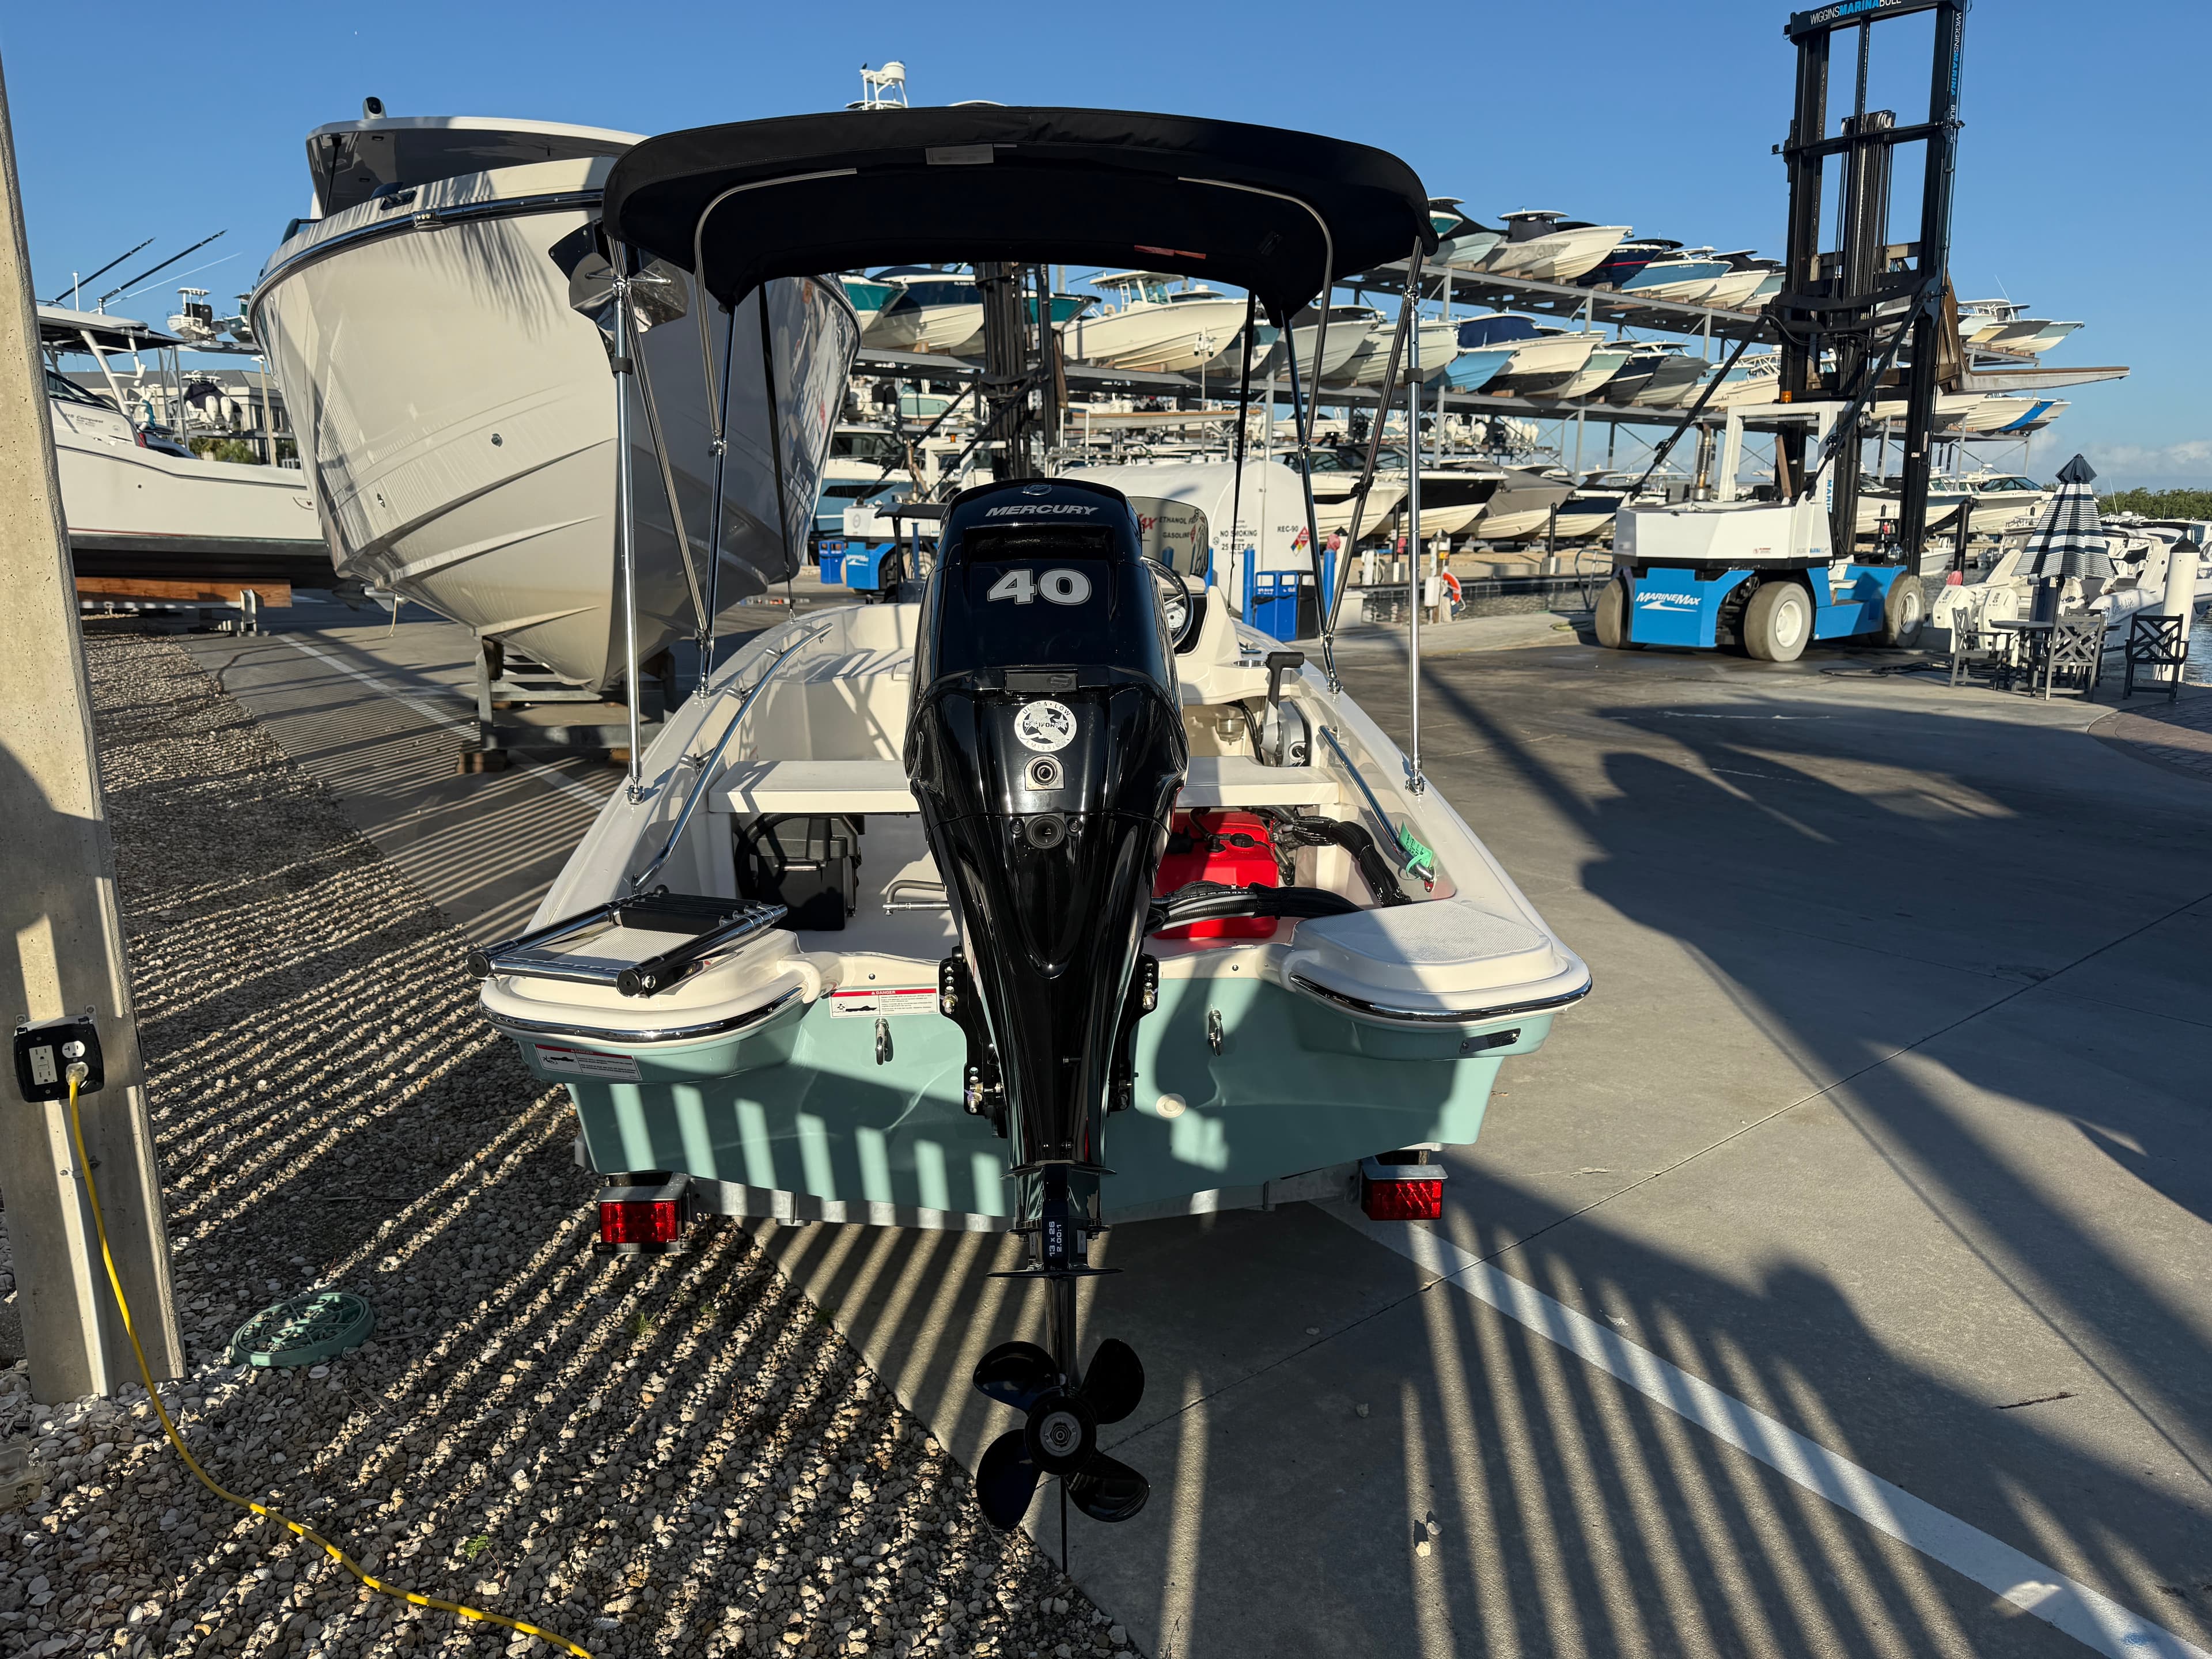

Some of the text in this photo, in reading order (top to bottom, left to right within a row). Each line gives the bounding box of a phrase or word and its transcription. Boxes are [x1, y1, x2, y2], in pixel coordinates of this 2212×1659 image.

[985, 505, 1099, 517] MERCURY
[987, 568, 1092, 605] 40
[1054, 703, 1071, 715] LOW
[1049, 1221, 1055, 1234] 26
[1049, 1245, 1055, 1257] 13
